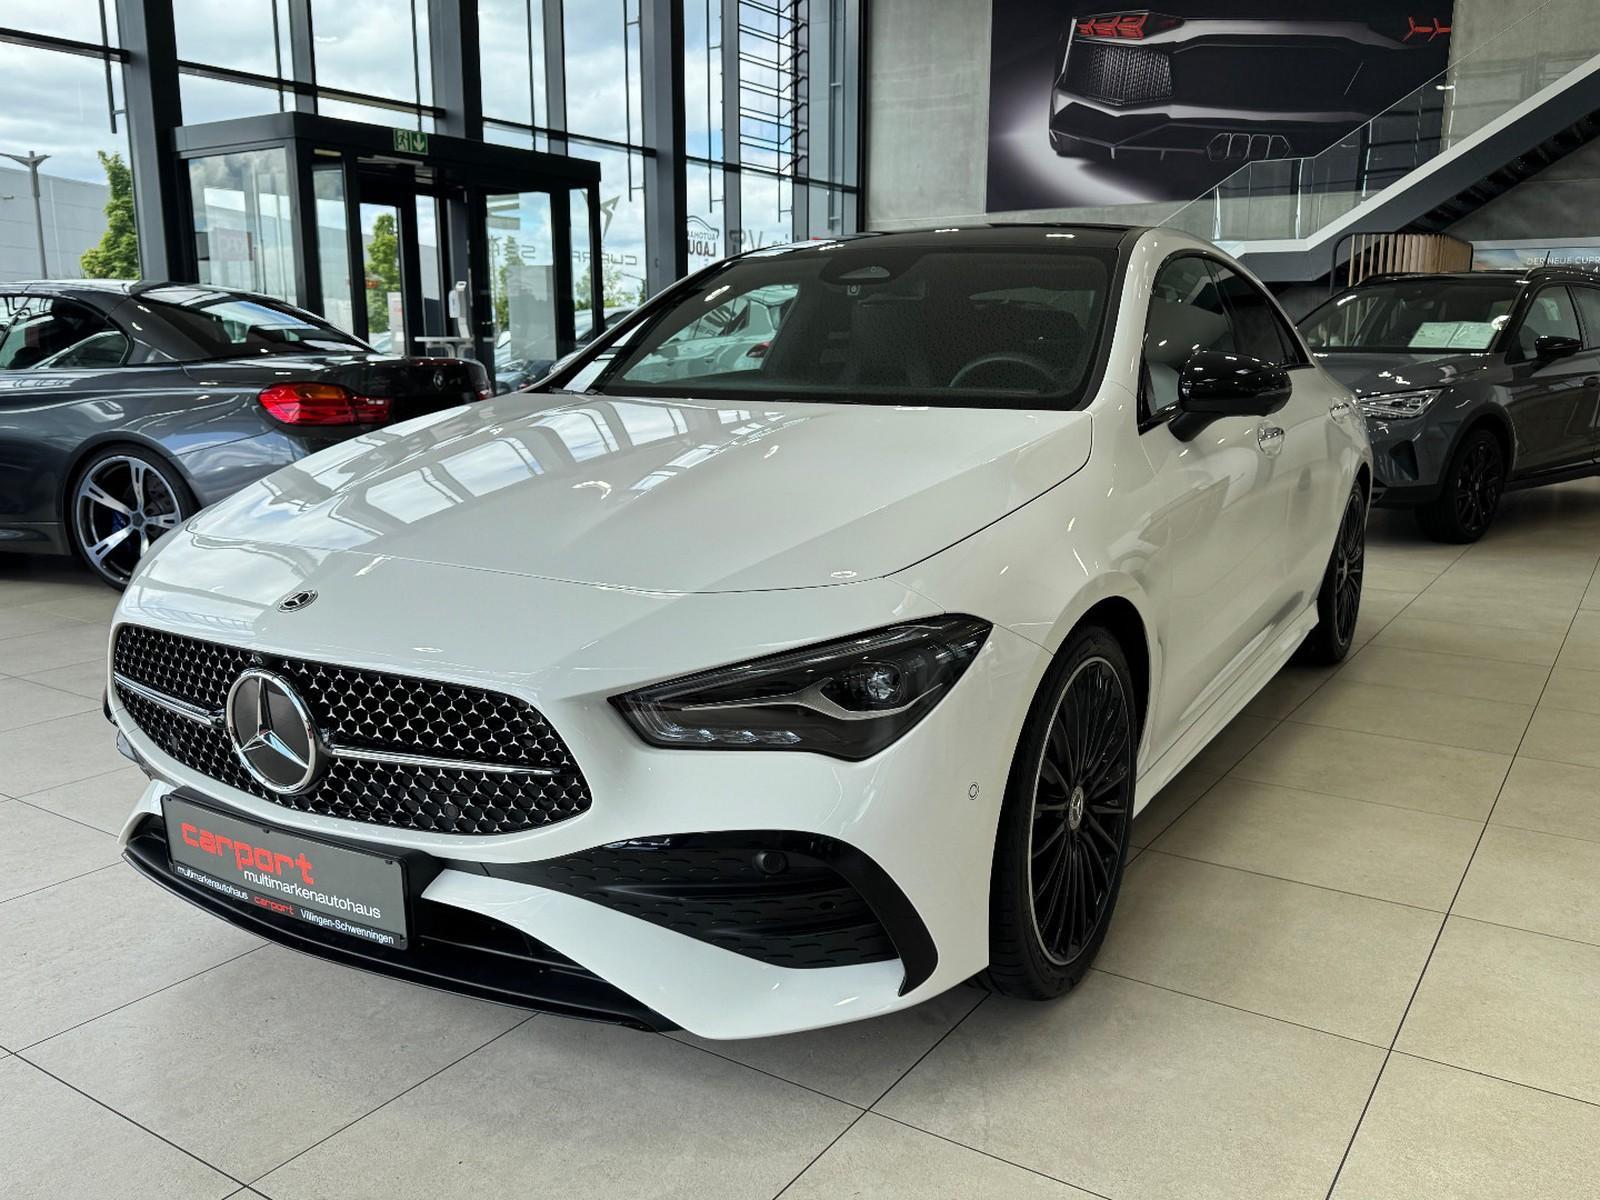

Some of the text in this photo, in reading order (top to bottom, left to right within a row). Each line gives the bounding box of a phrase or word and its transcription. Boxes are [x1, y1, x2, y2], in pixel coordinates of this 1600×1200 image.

[1526, 257, 1545, 265] DER
[1547, 256, 1572, 265] NEUE
[181, 822, 314, 885] carport
[177, 865, 394, 944] multimarkenautohaus carport Villingen-Schwenningen
[244, 870, 381, 919] multimarkenautohaus
